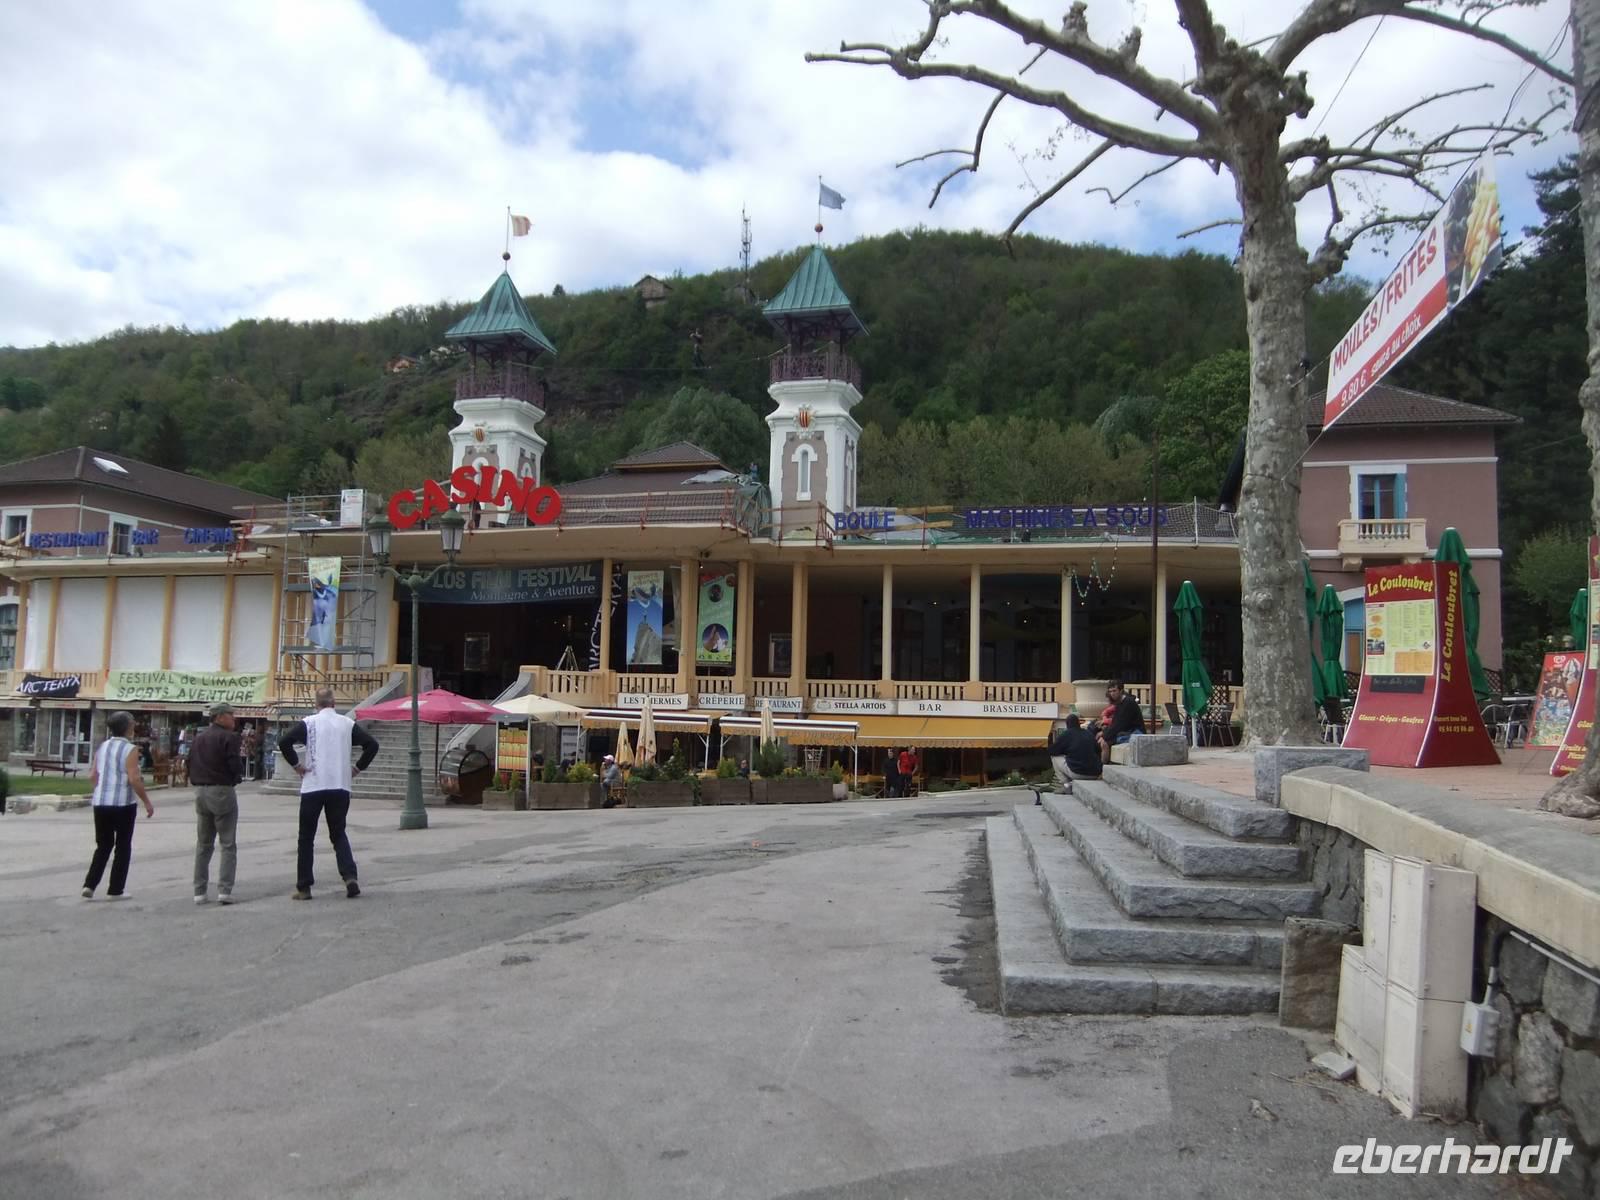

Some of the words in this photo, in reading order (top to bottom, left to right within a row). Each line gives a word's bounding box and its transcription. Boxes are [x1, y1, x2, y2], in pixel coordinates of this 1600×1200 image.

[1390, 335, 1401, 355] au
[1401, 312, 1422, 343] choix
[388, 465, 563, 530] CASINO
[833, 511, 897, 531] BOULE
[965, 506, 1073, 529] MACHINES
[1083, 507, 1098, 528] A
[1105, 504, 1169, 528] SOUS
[30, 531, 110, 549] RESTAURANT
[132, 528, 160, 545] BAR
[183, 528, 234, 545] CINEMA
[471, 568, 512, 589] FILM
[517, 564, 597, 588] FESTIVAL
[1367, 583, 1379, 597] Le
[1379, 574, 1435, 593] Couloubret
[531, 588, 540, 599] &
[543, 583, 597, 598] Aventure
[1442, 569, 1459, 659] Couloubret
[119, 672, 175, 686] FESTIVAL
[180, 675, 197, 686] de
[201, 676, 257, 688] L'IMAGE
[1440, 661, 1453, 683] Le
[116, 686, 169, 699] SPORTS
[176, 687, 255, 704] AVENTURE
[623, 696, 640, 705] LES
[698, 694, 745, 706] CRÊPERIE
[755, 699, 801, 710] RETAURANT
[834, 701, 859, 710] STELLA
[860, 702, 887, 710] ARTOIS
[918, 702, 943, 712] BAR
[982, 703, 1038, 714] BRASSERIE
